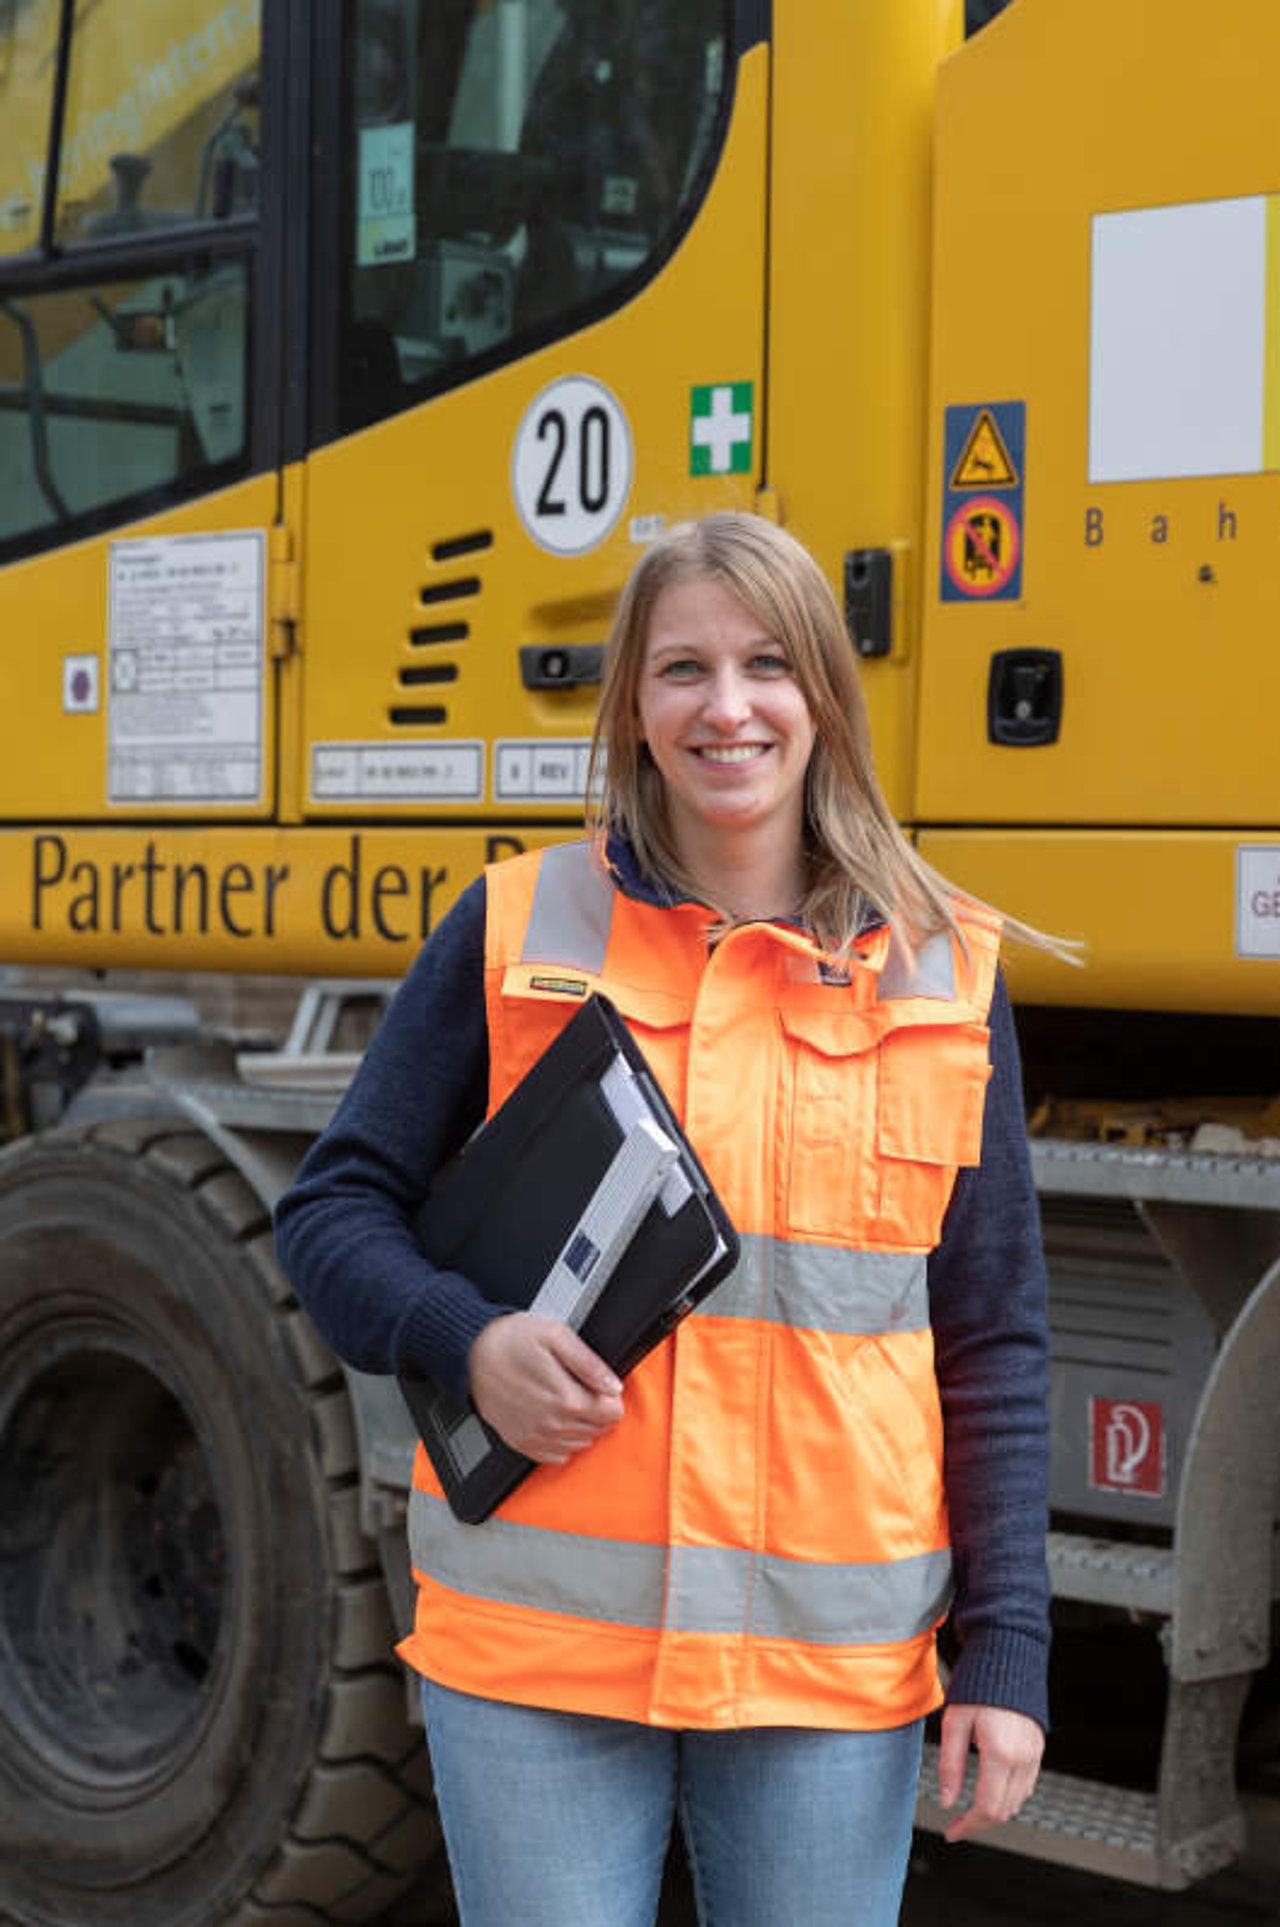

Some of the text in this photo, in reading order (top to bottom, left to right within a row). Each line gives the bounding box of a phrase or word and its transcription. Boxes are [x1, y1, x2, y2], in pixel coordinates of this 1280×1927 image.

[537, 406, 610, 516] 20
[33, 833, 447, 942] Partner der
